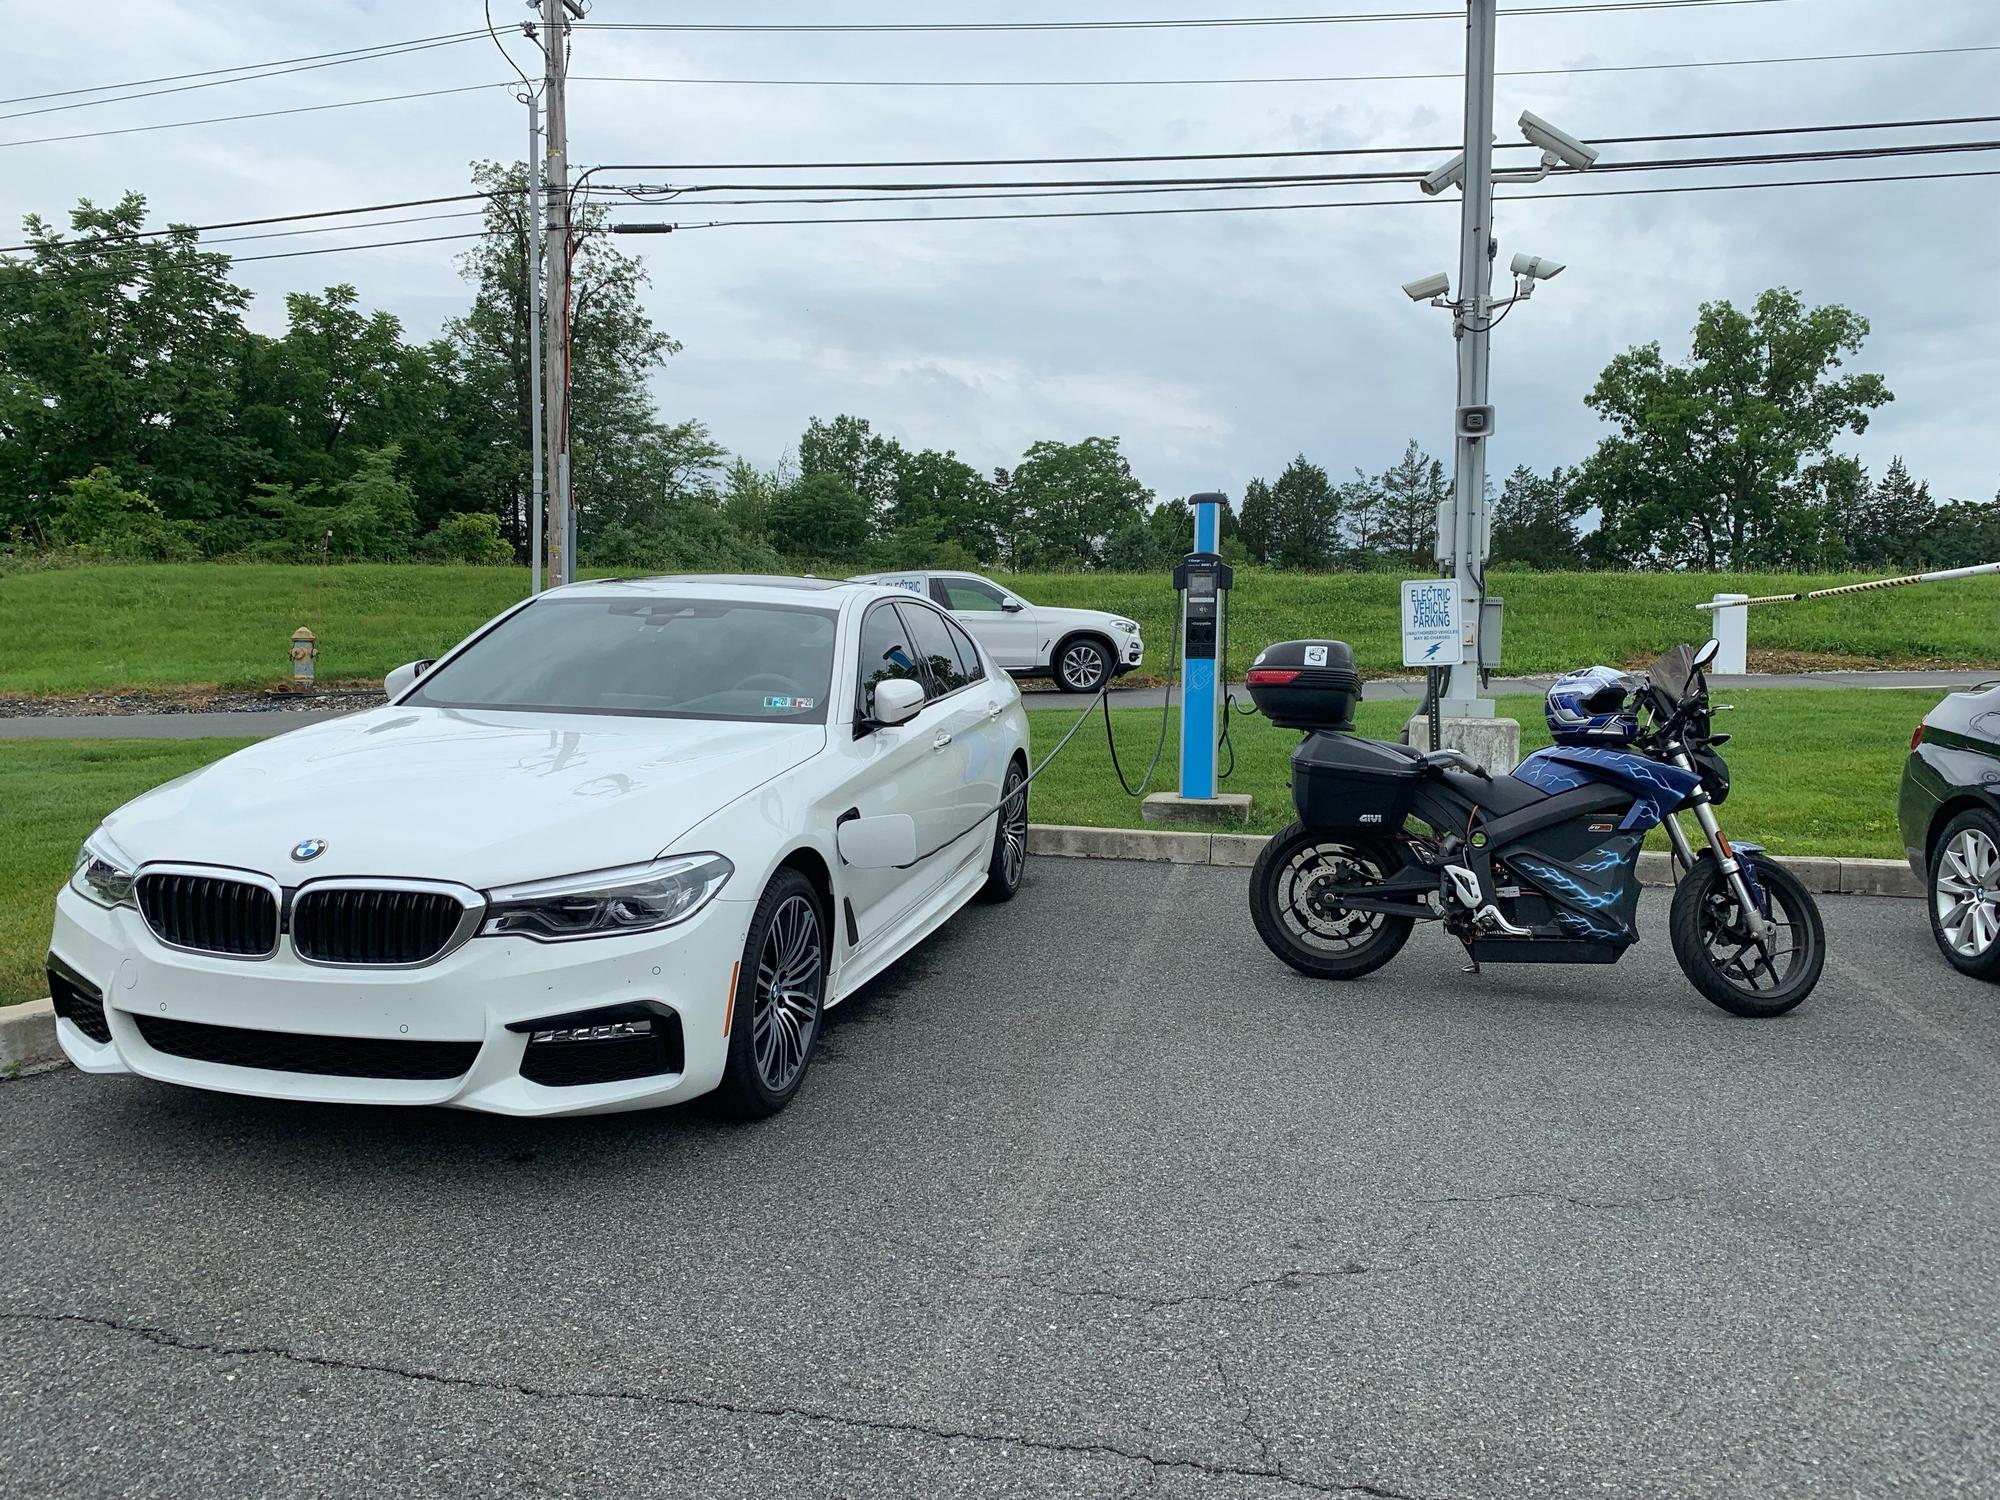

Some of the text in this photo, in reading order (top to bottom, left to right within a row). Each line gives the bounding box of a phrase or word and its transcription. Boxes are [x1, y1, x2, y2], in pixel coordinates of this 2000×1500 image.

[1411, 588, 1451, 602] ELECTRIC
[1413, 601, 1449, 615] VEHICLE
[1413, 614, 1450, 628] PARKING
[1358, 814, 1382, 823] GIVI
